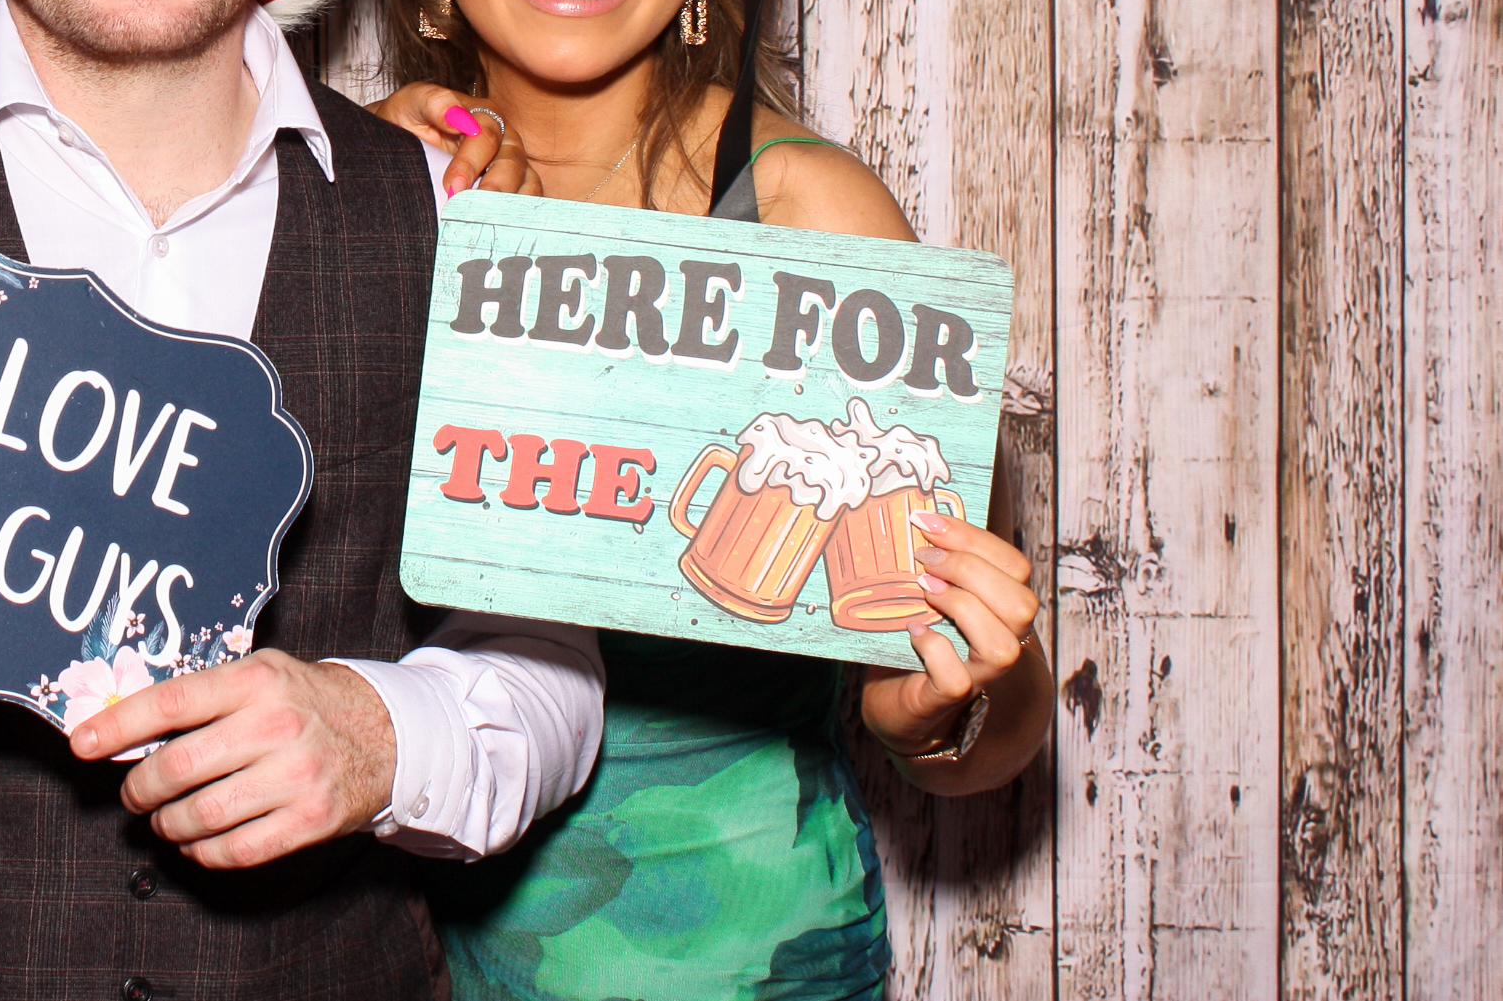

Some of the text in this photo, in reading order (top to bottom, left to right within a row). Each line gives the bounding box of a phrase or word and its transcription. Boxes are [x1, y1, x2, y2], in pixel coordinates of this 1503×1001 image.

[449, 253, 982, 403] HERE FOR
[432, 424, 657, 524] THE
